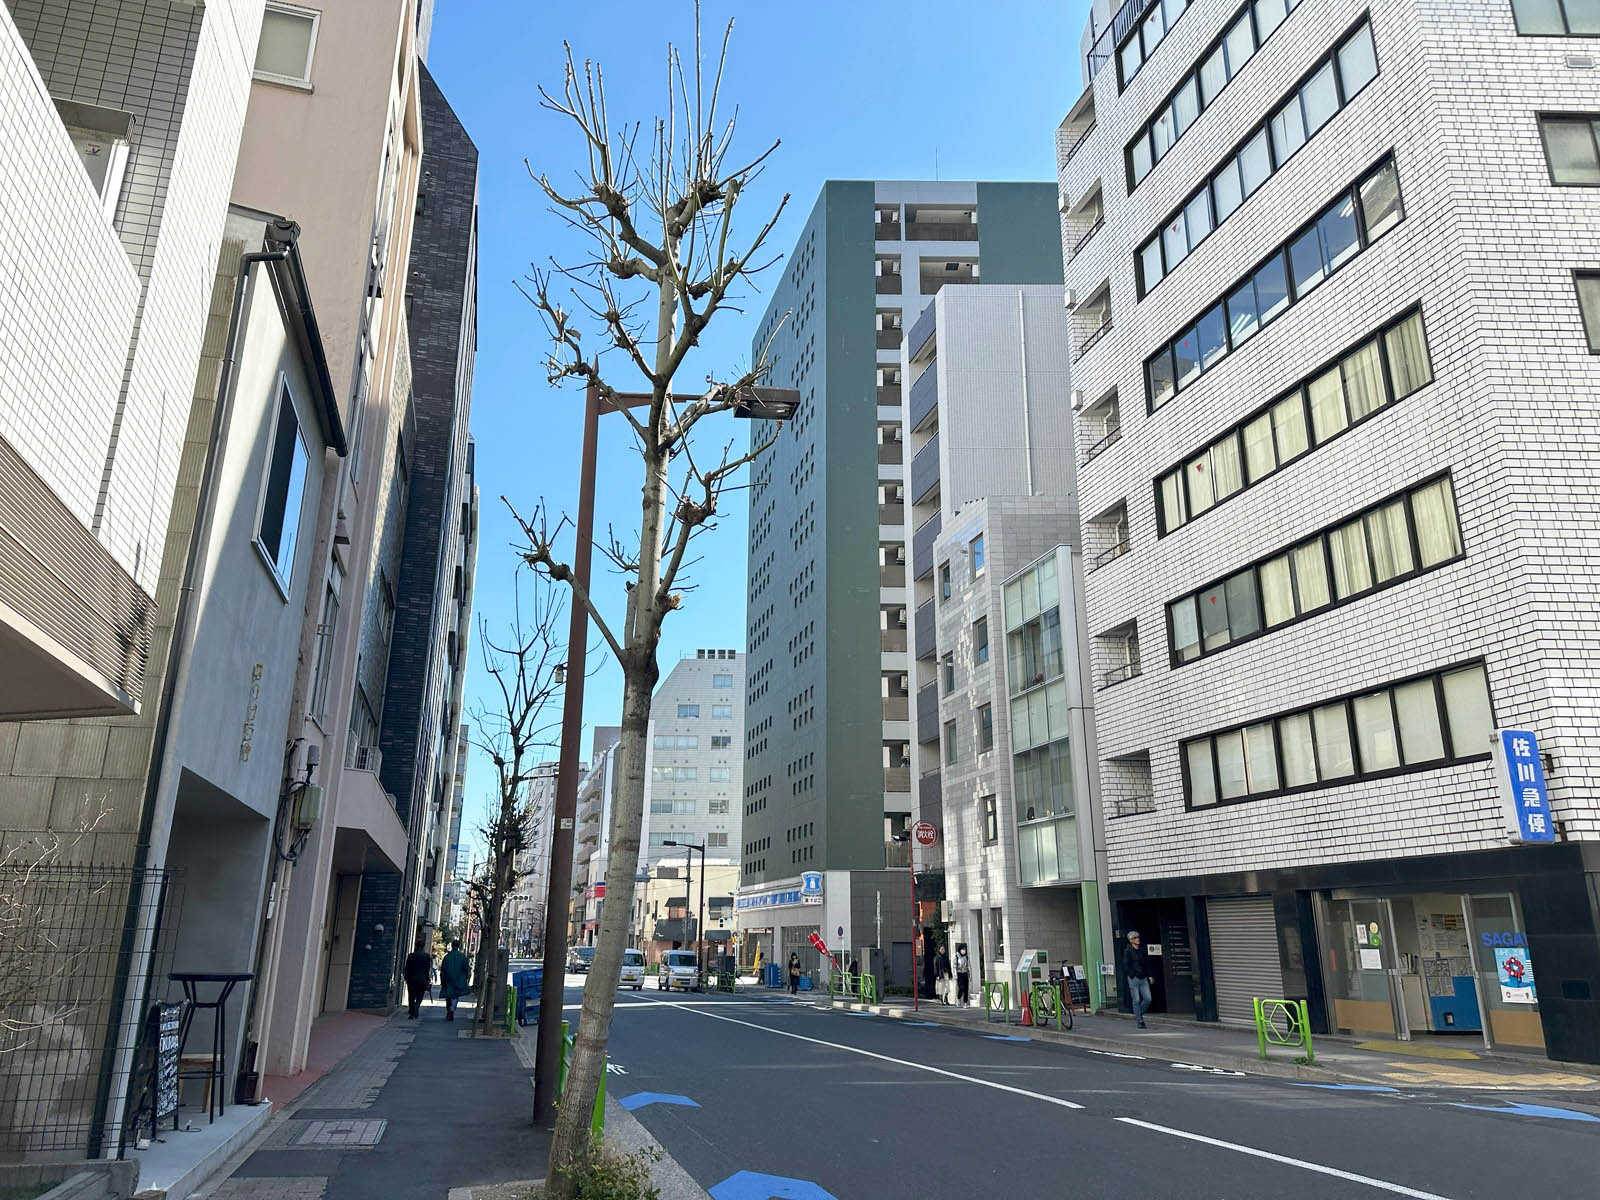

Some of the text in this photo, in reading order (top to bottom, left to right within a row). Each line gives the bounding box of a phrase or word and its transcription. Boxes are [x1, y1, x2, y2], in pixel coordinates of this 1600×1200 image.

[1512, 737, 1546, 833] 佐川急便
[917, 830, 934, 839] 消火栓
